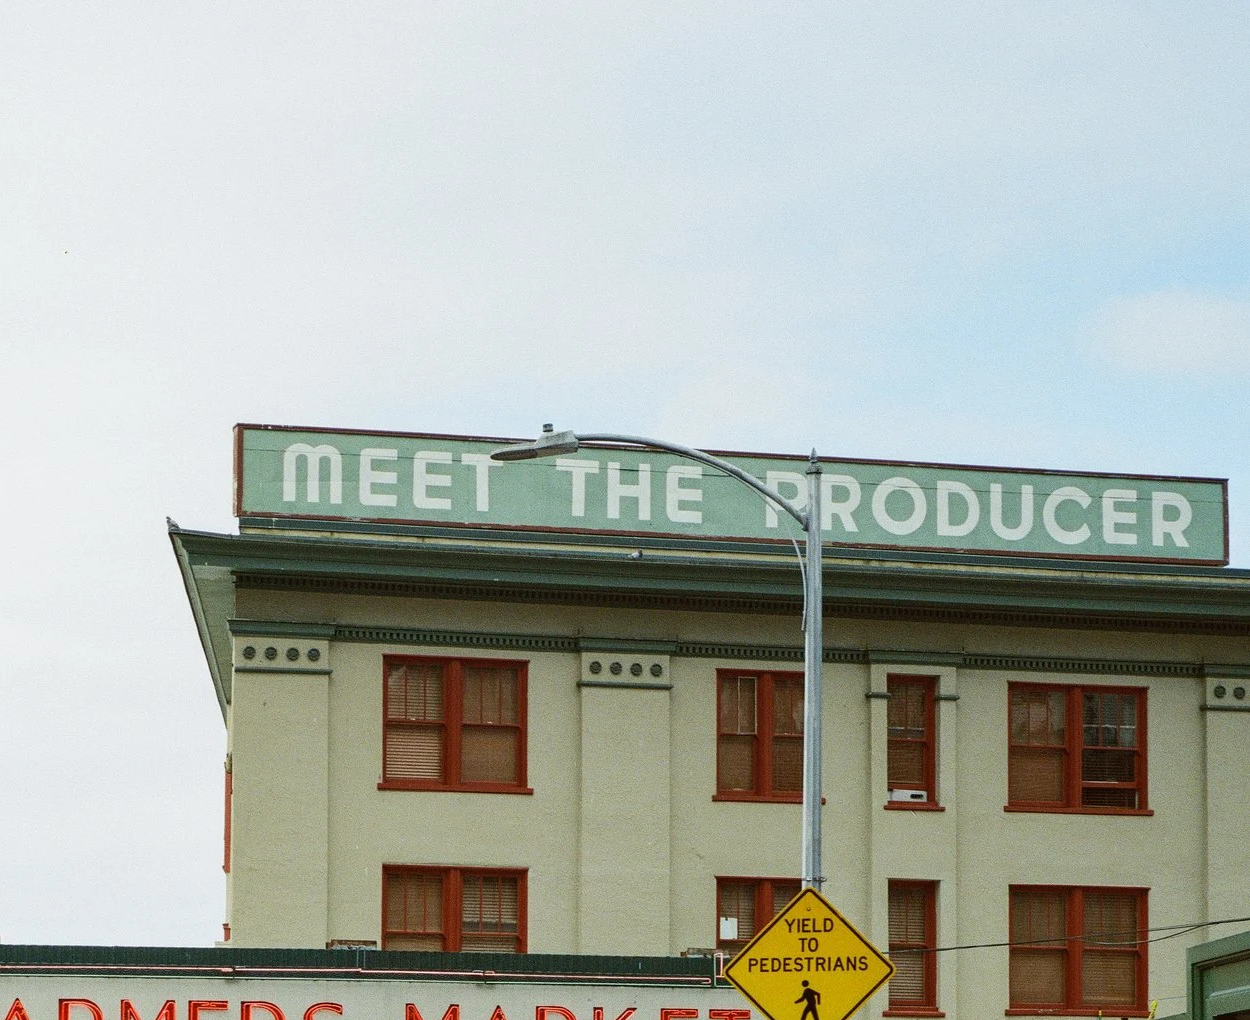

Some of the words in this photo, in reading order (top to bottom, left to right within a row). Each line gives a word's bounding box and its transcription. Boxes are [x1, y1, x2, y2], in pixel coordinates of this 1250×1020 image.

[282, 443, 504, 512] MEET
[555, 457, 703, 524] THE
[763, 470, 1192, 548] PRODUCER
[784, 918, 834, 933] YIELD
[798, 937, 819, 953] TO
[748, 956, 869, 973] PEDESTRIANS
